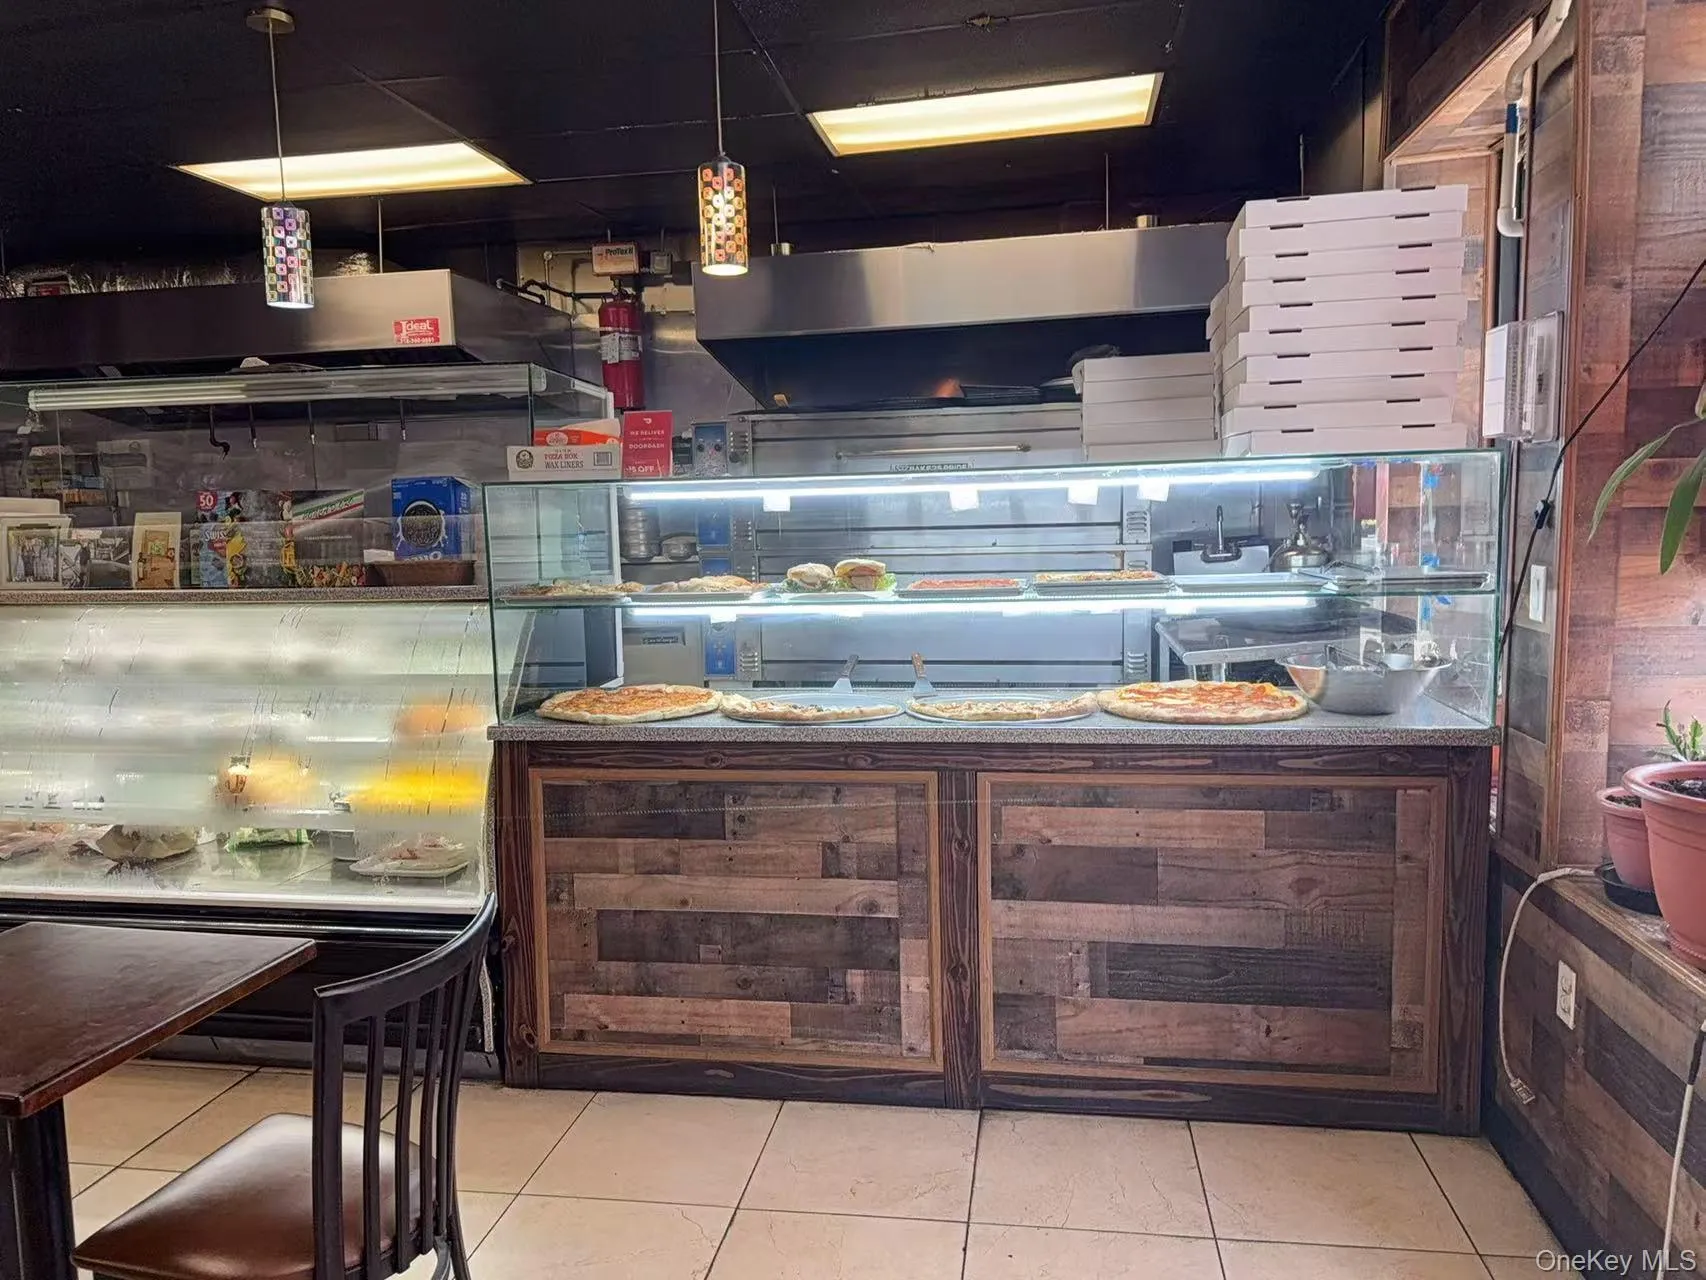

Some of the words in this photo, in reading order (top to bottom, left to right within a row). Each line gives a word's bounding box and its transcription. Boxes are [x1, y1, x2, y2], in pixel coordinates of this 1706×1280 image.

[544, 460, 559, 469] WAX
[560, 460, 584, 468] LINERS
[638, 465, 655, 473] OFF
[200, 495, 214, 507] 50
